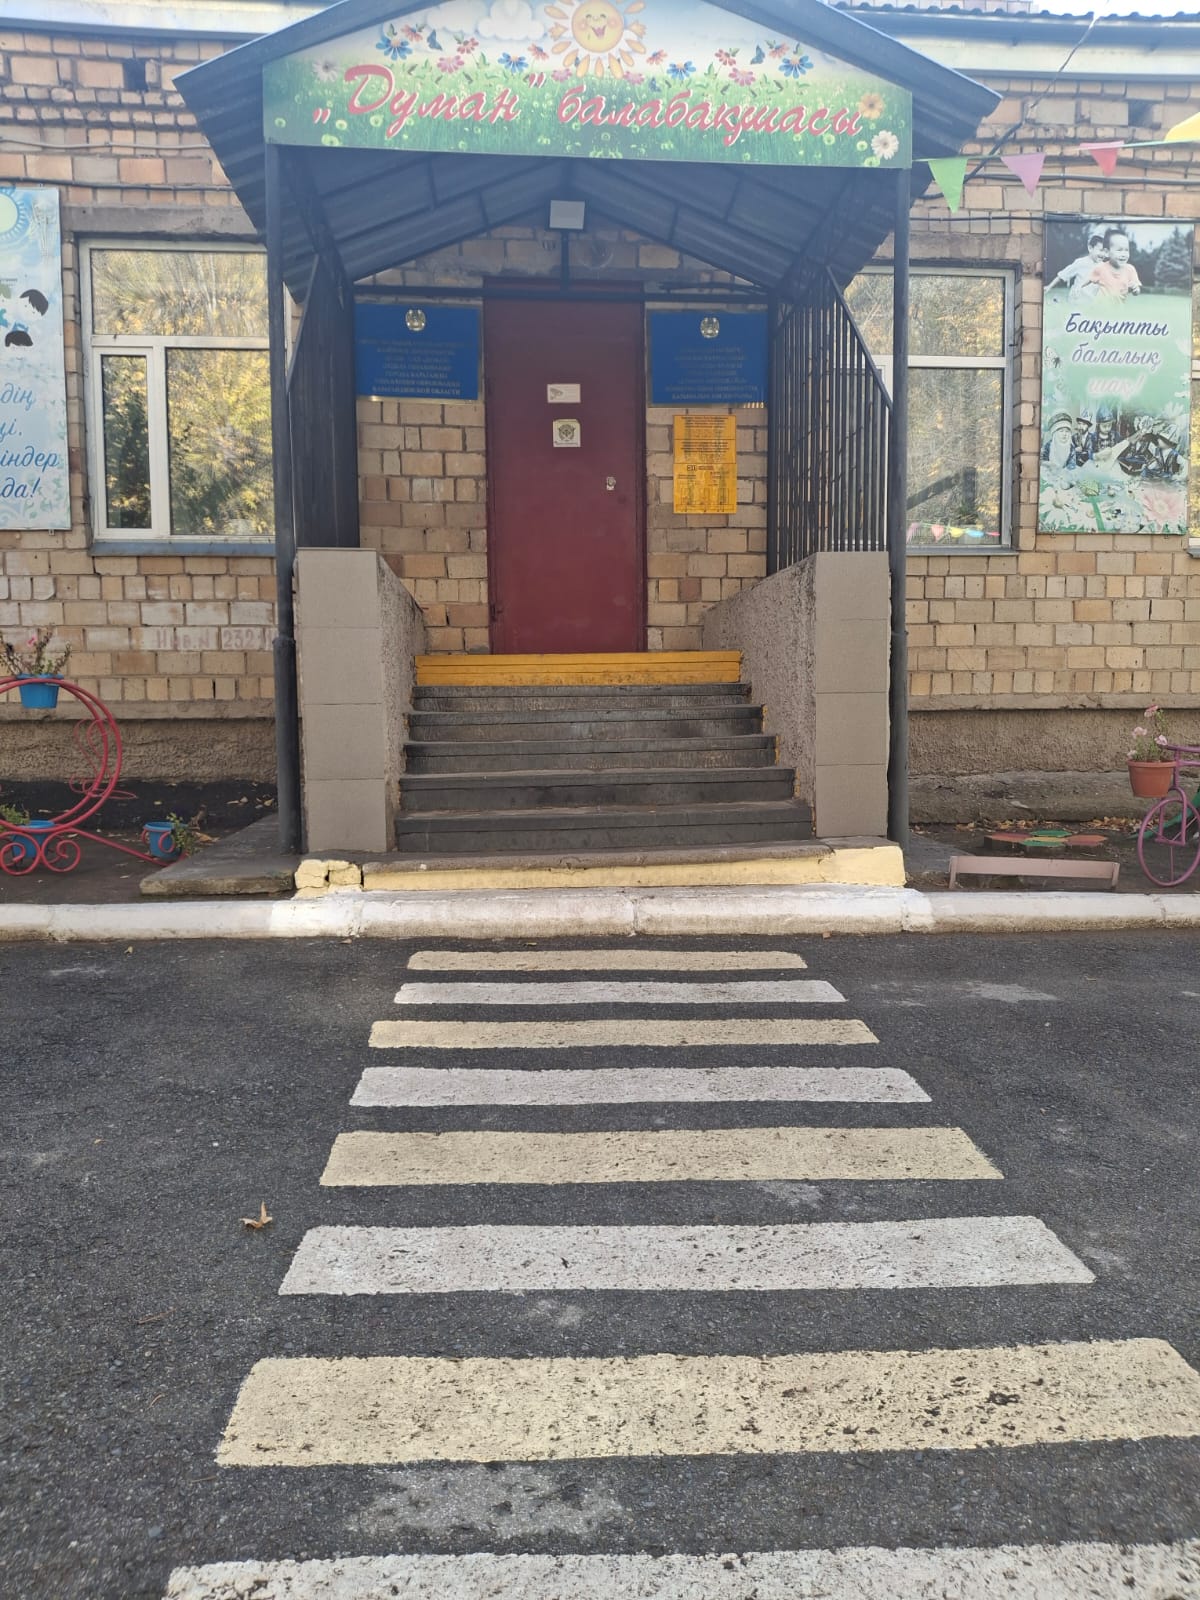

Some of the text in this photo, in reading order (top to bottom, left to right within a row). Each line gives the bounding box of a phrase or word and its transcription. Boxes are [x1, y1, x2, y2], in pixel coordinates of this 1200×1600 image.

[556, 84, 863, 147] балабақшасы
[1065, 312, 1169, 340] Бақытты
[1072, 342, 1161, 371] балалық
